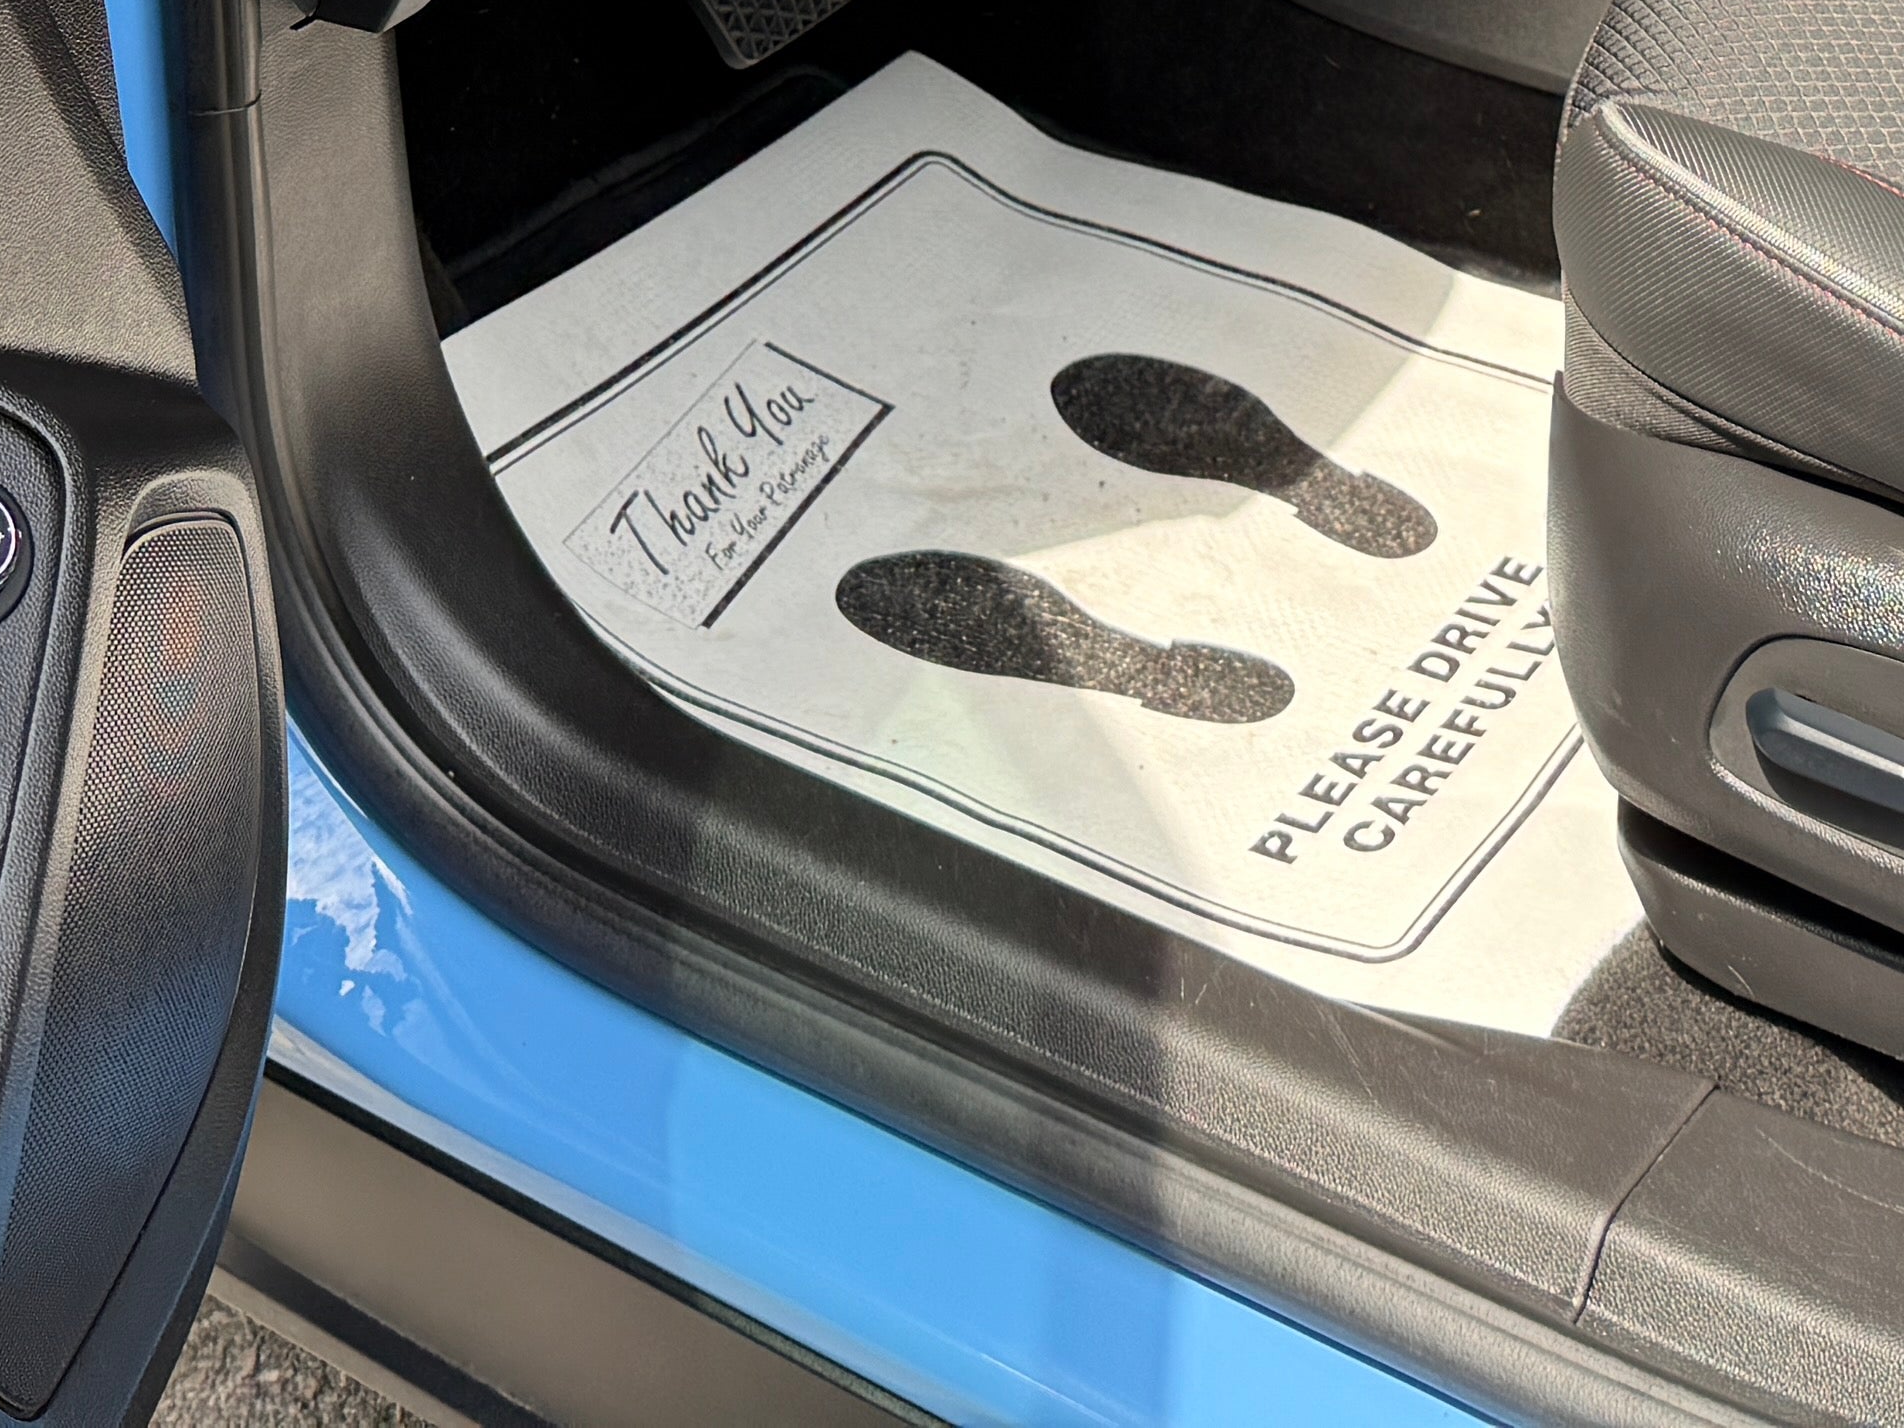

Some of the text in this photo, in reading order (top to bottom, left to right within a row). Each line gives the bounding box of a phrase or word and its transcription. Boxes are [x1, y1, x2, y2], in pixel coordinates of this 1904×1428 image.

[609, 381, 816, 576] Thank You
[705, 434, 830, 571] For Your Patronage
[1248, 555, 1544, 865] PLEASE DRIVE
